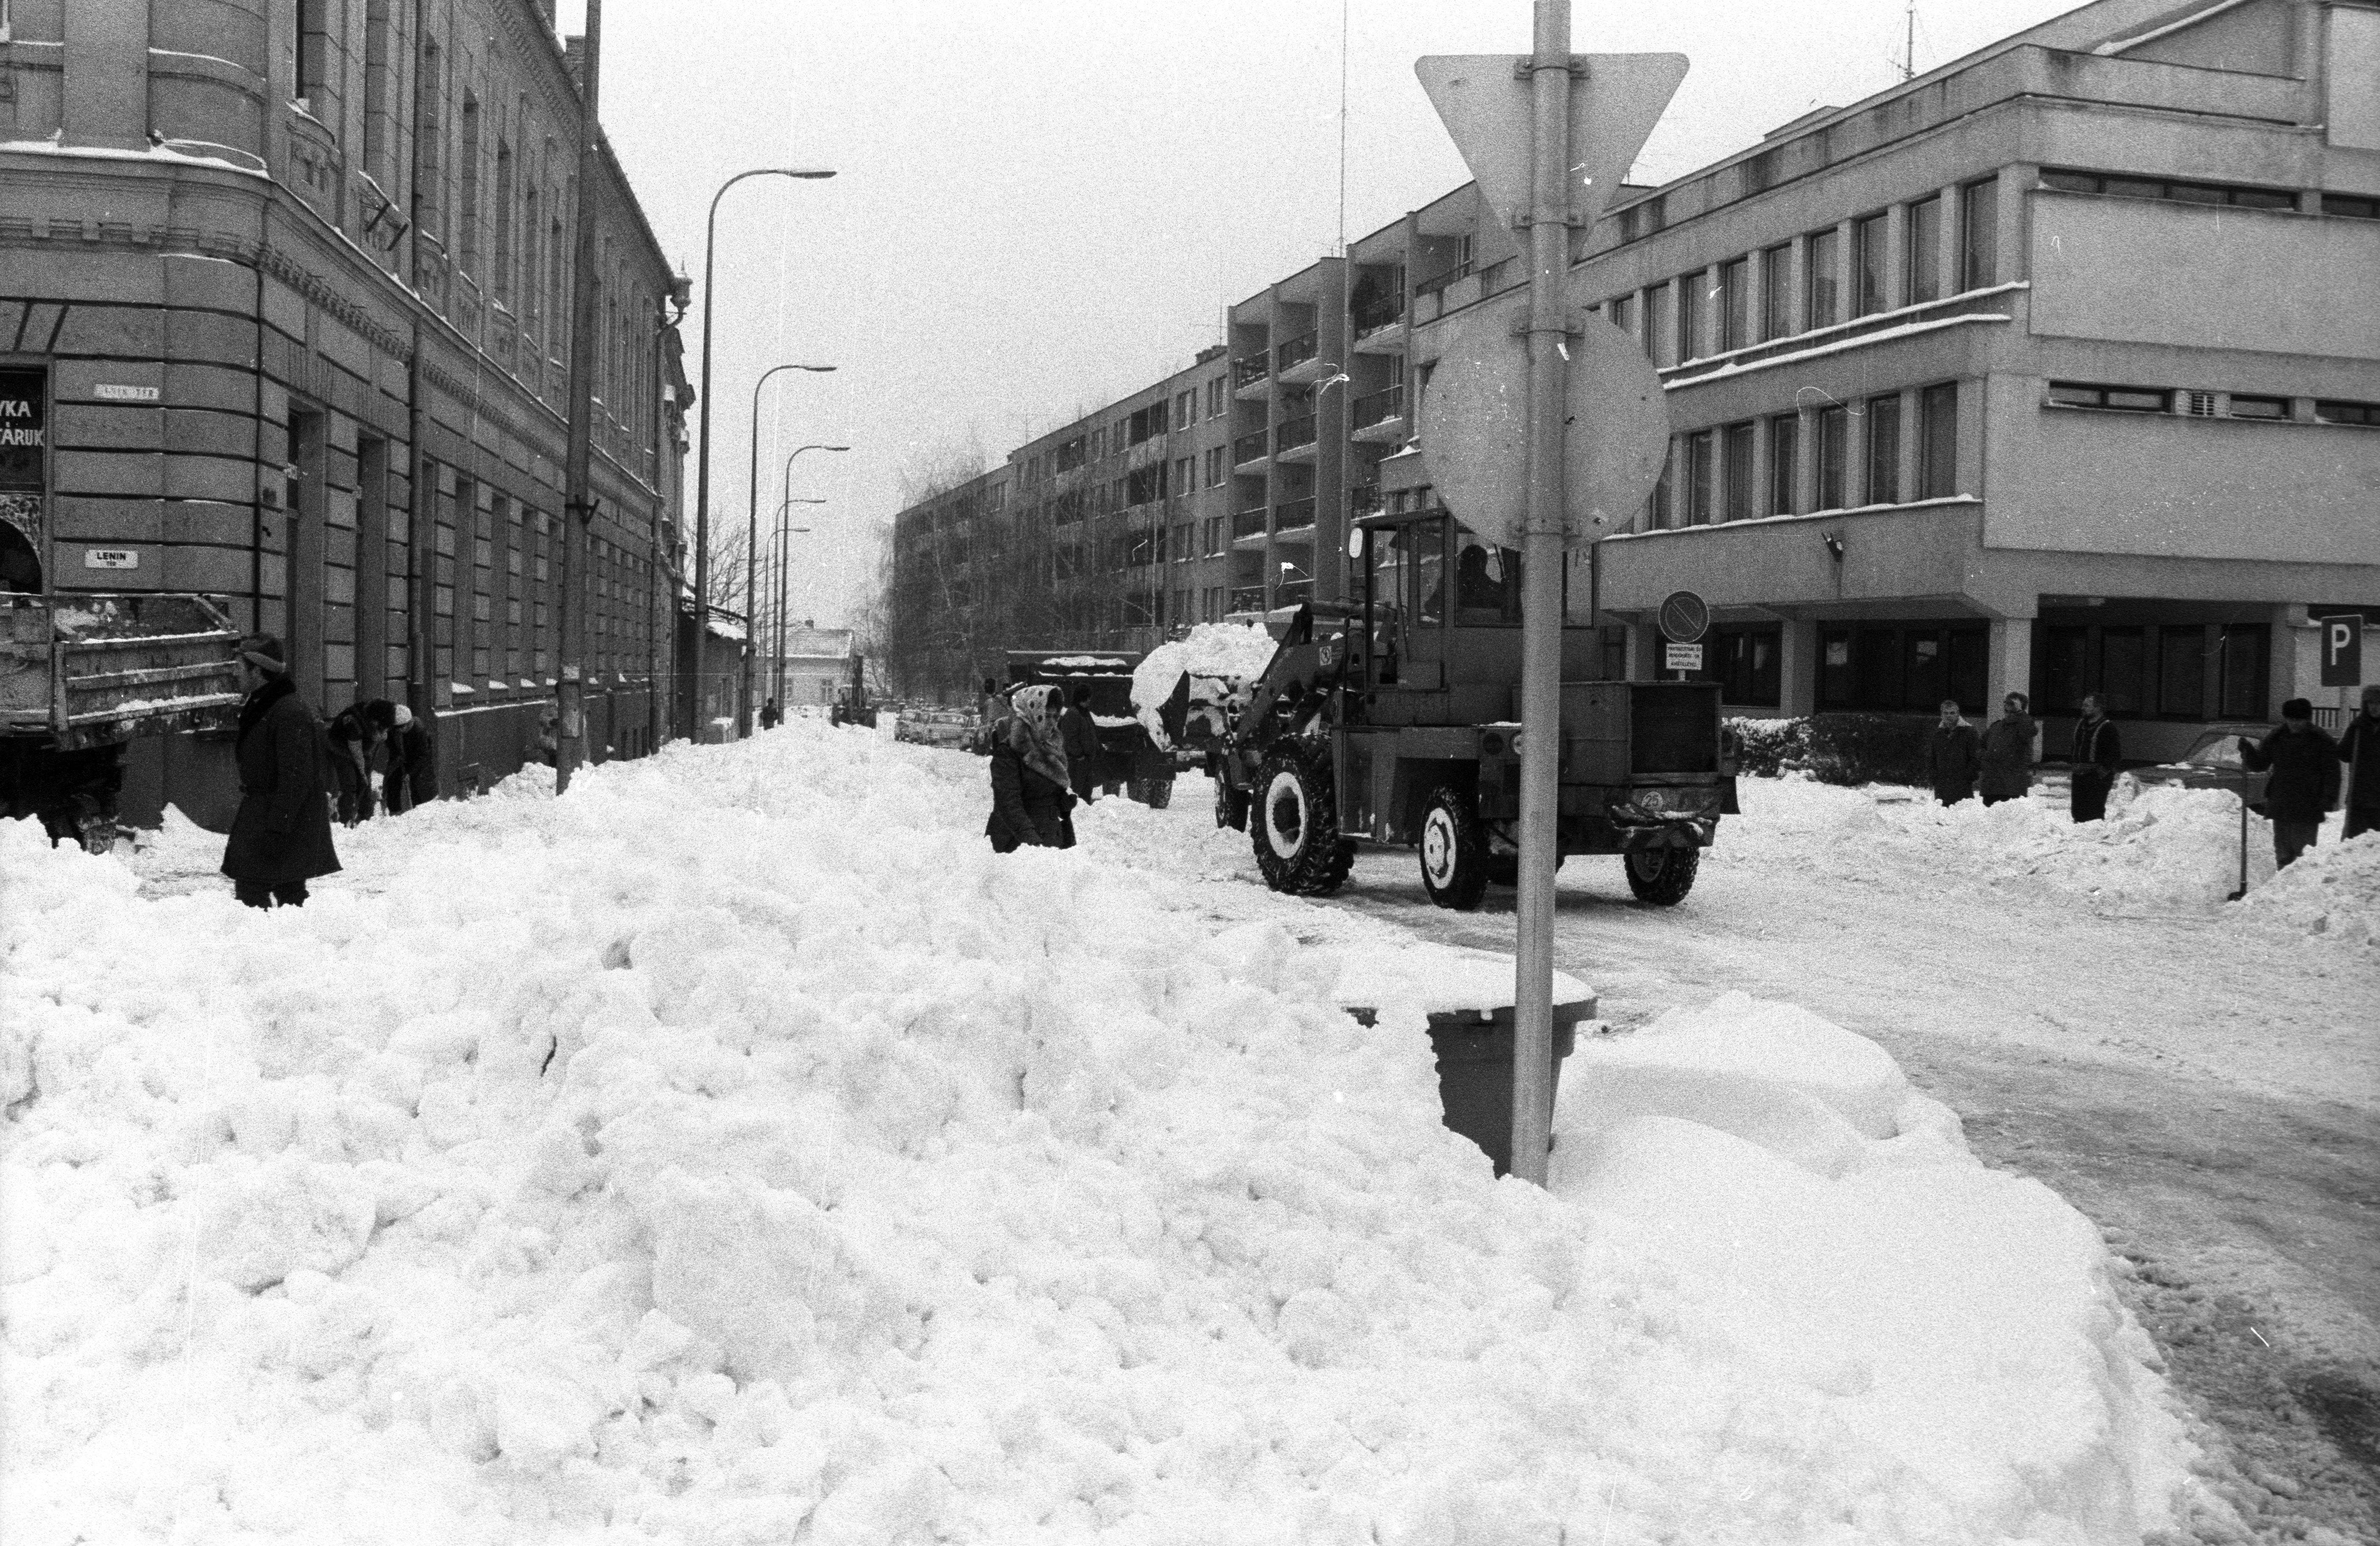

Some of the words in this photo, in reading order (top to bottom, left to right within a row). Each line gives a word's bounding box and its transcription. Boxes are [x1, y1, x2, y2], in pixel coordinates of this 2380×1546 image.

[97, 552, 126, 560] LENIN
[2331, 623, 2350, 665] P
[1642, 795, 1659, 807] 25
